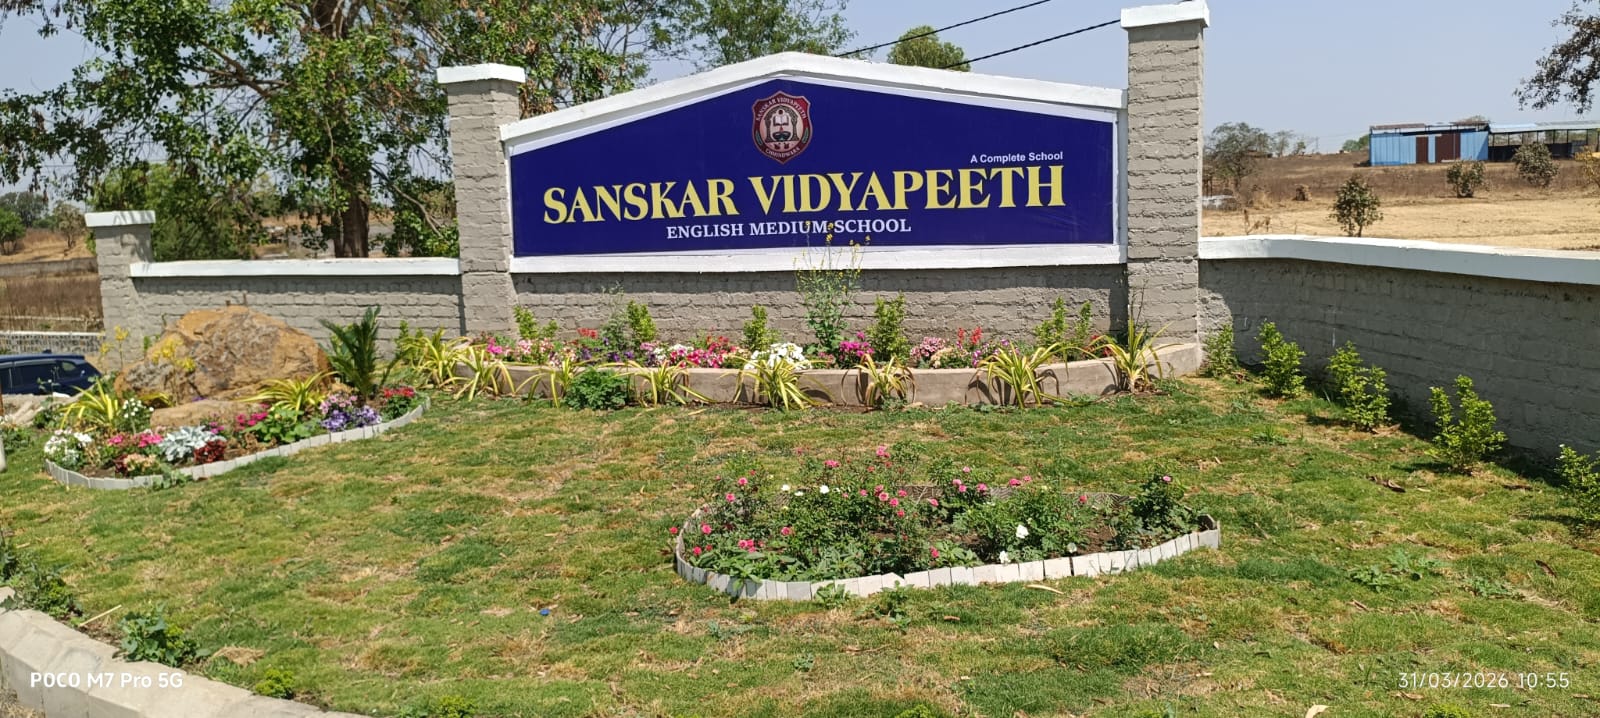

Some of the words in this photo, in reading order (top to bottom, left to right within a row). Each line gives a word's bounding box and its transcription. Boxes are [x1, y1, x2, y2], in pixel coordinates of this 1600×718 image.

[970, 154, 978, 163] A
[979, 153, 1026, 164] Complete
[1028, 151, 1064, 161] School
[543, 178, 740, 224] SANSKAR
[747, 164, 1066, 216] VIDYAPEETH
[666, 223, 744, 239] ENGLISH
[749, 220, 828, 236] MEDIUM
[833, 218, 912, 233] SCHOOL
